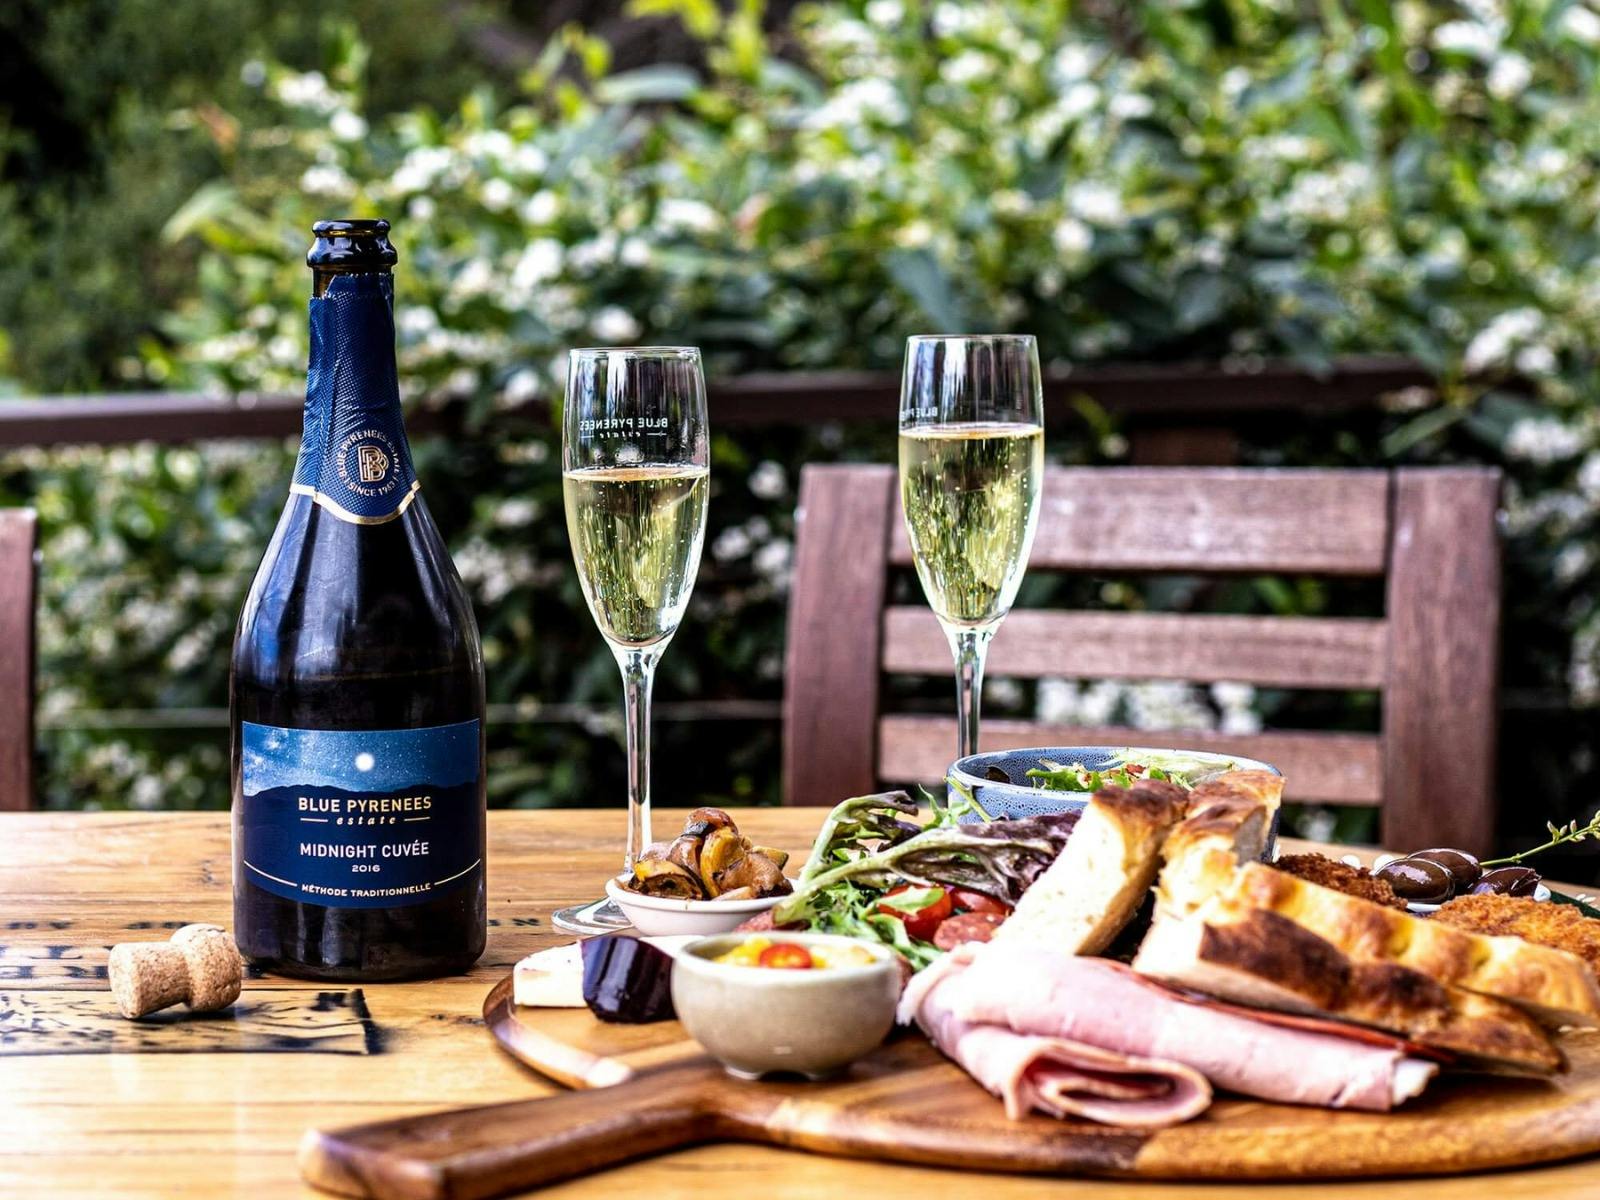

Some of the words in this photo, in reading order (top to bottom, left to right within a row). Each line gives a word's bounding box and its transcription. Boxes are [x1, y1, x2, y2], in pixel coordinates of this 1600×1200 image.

[341, 429, 387, 451] PYRENEES
[337, 451, 348, 480] BLUE
[347, 481, 377, 496] SINCE
[298, 797, 341, 812] BLUE
[347, 796, 432, 813] PYRENEES
[336, 815, 396, 826] estate
[300, 843, 377, 858] MIDNIGHT
[381, 839, 430, 858] CUVÉE
[351, 864, 381, 873] 2016
[301, 884, 348, 897] MÉTHODE
[350, 882, 432, 898] TRADITIONNELLE
